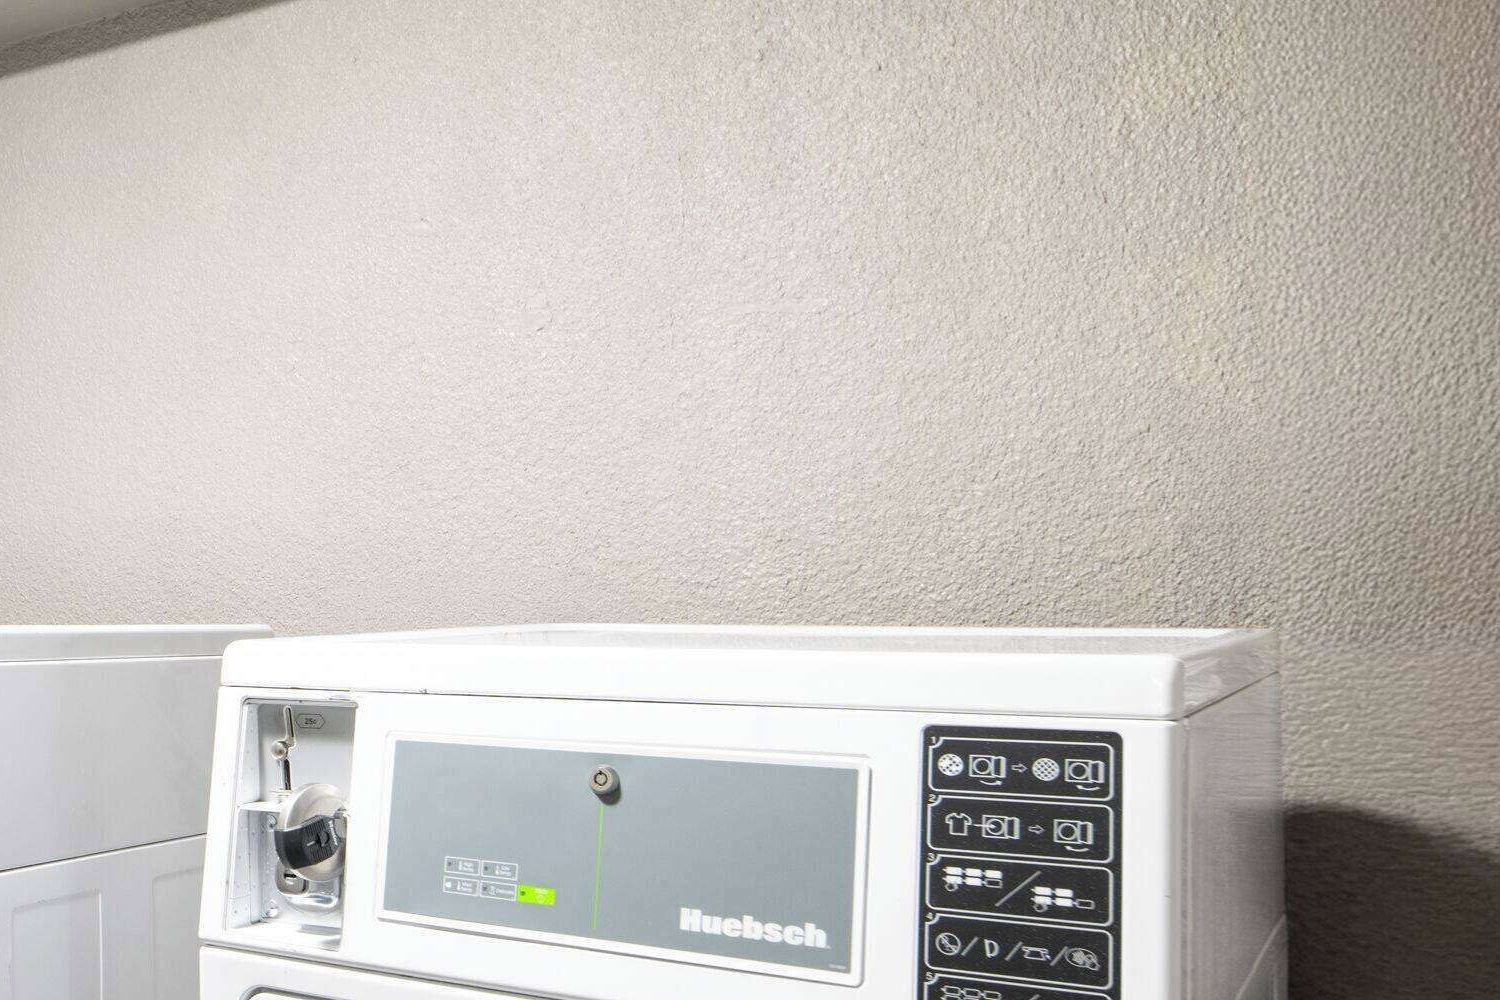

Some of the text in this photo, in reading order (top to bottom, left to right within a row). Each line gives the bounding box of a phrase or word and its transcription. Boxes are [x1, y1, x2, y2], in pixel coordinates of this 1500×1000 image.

[931, 736, 937, 744] 1
[928, 794, 937, 803] 2
[927, 853, 935, 861] 3
[925, 912, 933, 921] 4
[679, 907, 828, 949] Huebsch
[925, 972, 933, 981] 5
